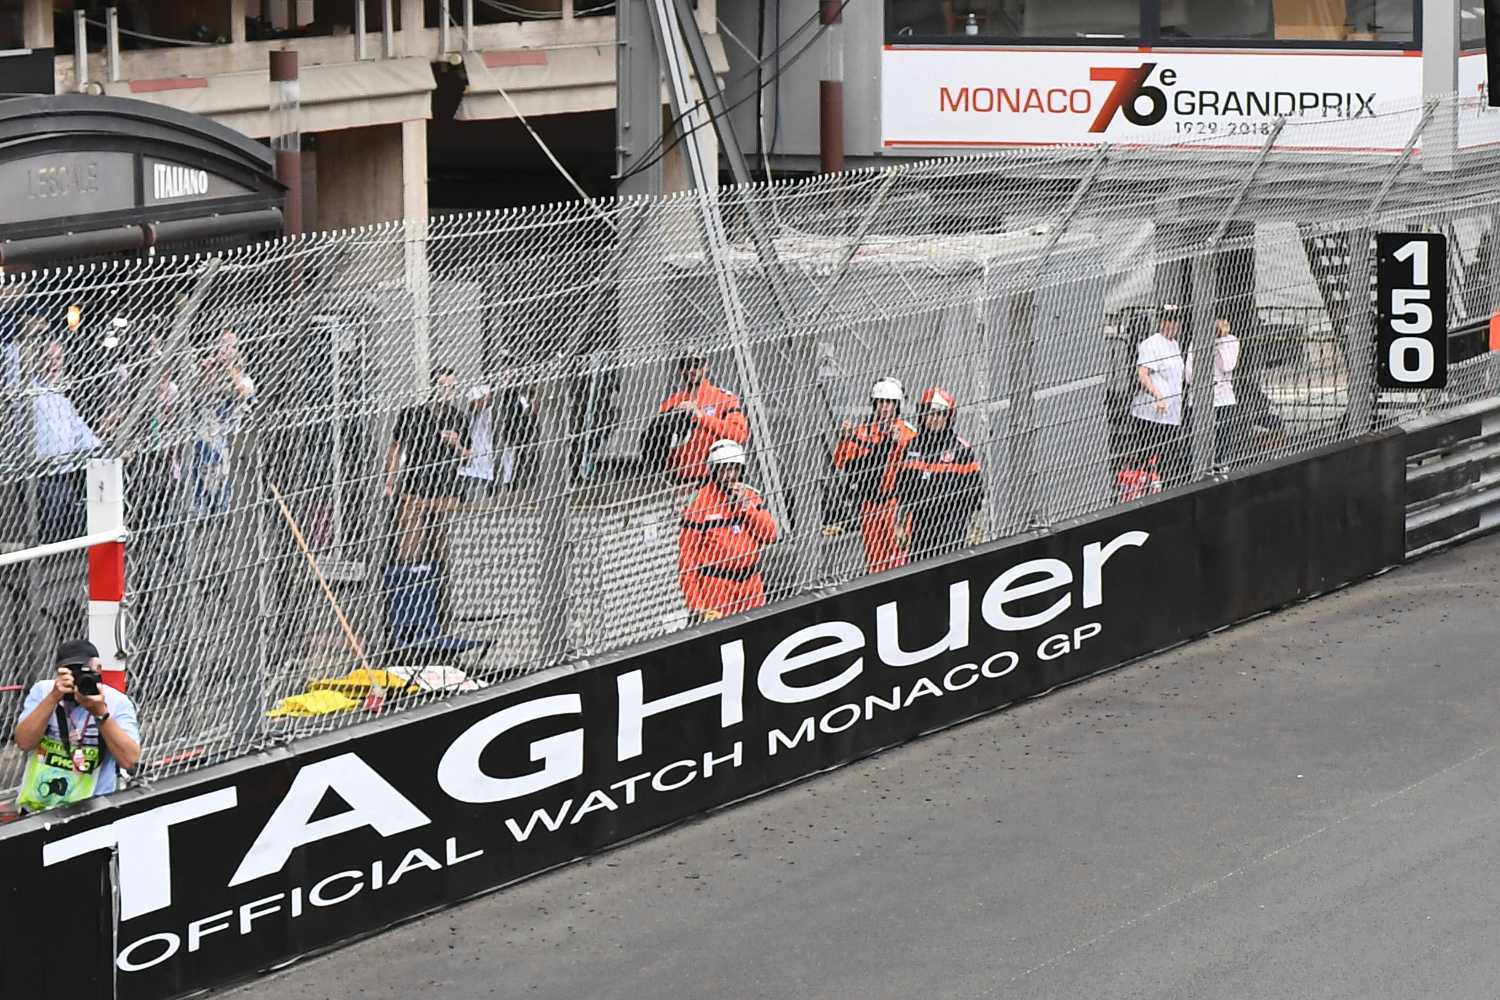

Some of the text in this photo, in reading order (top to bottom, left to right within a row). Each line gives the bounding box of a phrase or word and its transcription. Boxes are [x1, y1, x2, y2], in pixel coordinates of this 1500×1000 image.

[939, 87, 1091, 113] MONACO
[153, 163, 208, 199] ITALIANO
[50, 755, 91, 771] PHOO
[116, 621, 1102, 973] OFFICIAL WATCH MONACO GP
